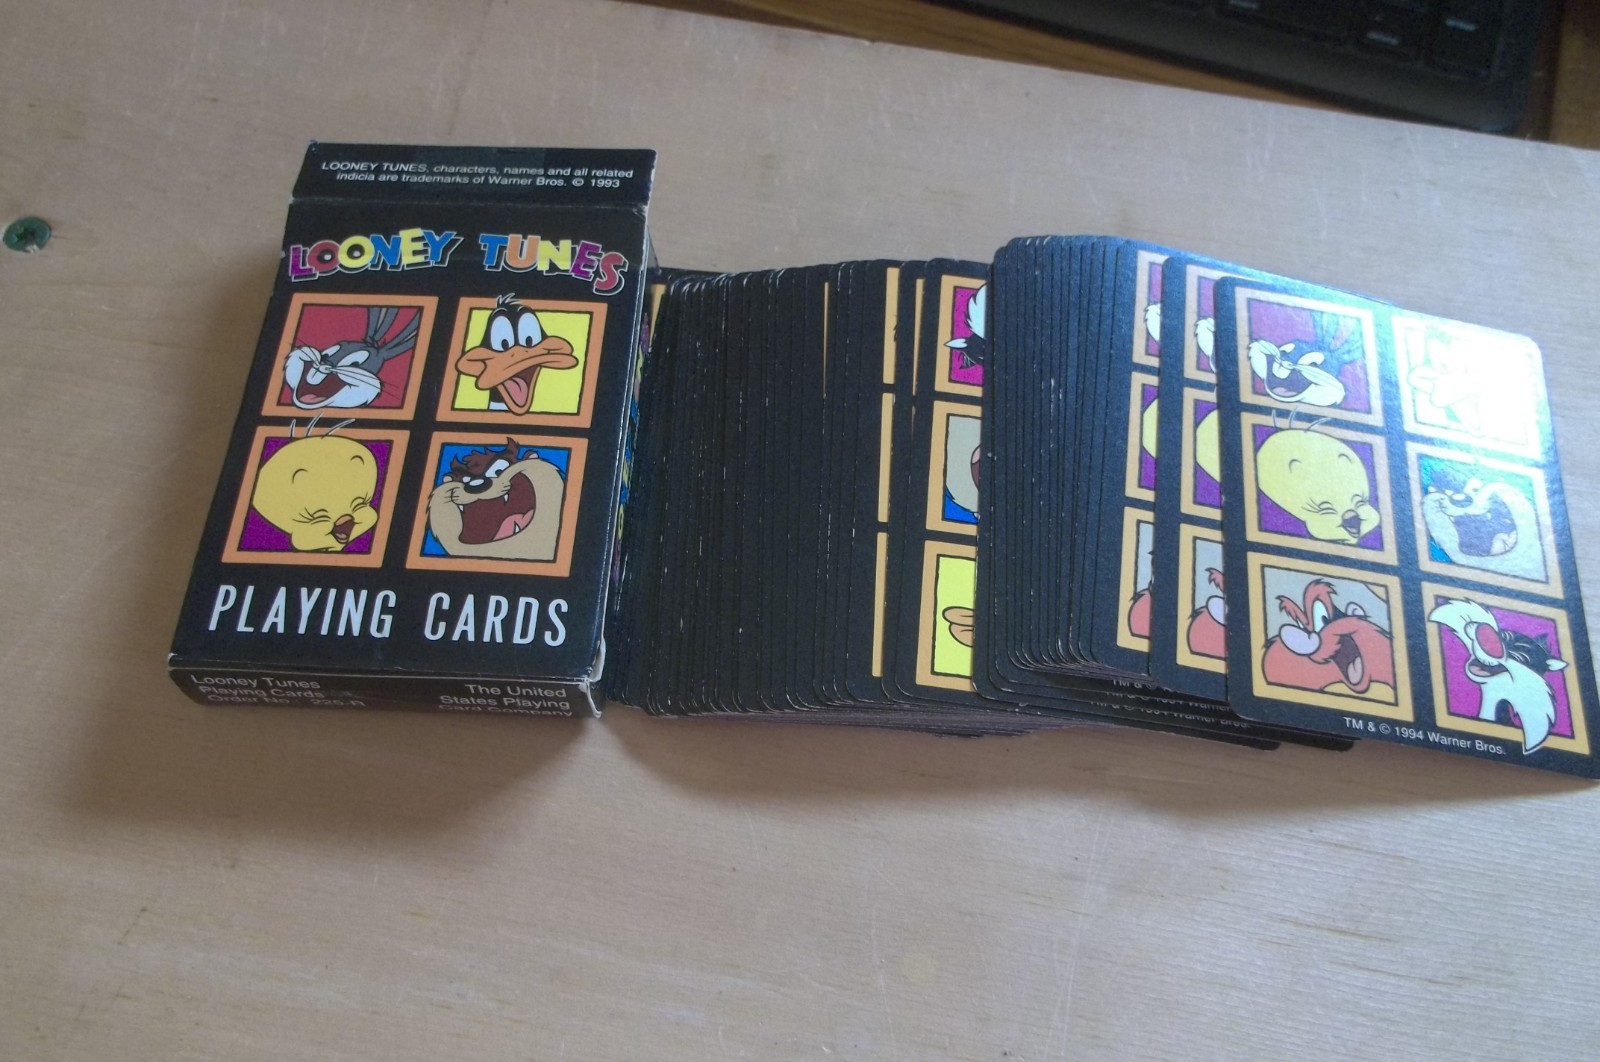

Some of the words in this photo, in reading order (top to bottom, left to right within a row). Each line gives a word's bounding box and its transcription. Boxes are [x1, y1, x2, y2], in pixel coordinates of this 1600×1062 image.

[321, 161, 379, 171] LOONEY
[382, 162, 430, 173] TUNES,
[433, 164, 499, 175] characters,
[503, 166, 545, 175] names
[547, 167, 571, 176] and
[574, 168, 588, 177] all
[591, 168, 634, 178] related
[336, 172, 375, 181] indicia
[378, 173, 399, 182] are
[401, 173, 470, 184] trademarks
[472, 175, 485, 184] of
[488, 176, 532, 186] Warner
[536, 177, 567, 187] Bros.
[590, 178, 620, 188] 1993
[288, 227, 464, 283] LOONEY
[478, 233, 629, 296] TUNES
[208, 584, 397, 639] PLAYING
[424, 591, 569, 647] CARDS
[190, 674, 258, 688] Looney
[261, 677, 321, 689] Tunes
[198, 685, 267, 697] Playing
[270, 688, 325, 698] Cards
[464, 684, 501, 695] The
[506, 685, 567, 698] United
[439, 695, 498, 706] States
[502, 697, 571, 710] Playing
[1343, 716, 1363, 730] TM
[1367, 721, 1376, 732] &
[1395, 726, 1424, 740] 1994
[1427, 731, 1472, 748] Warner
[1474, 739, 1507, 755] Bros.
